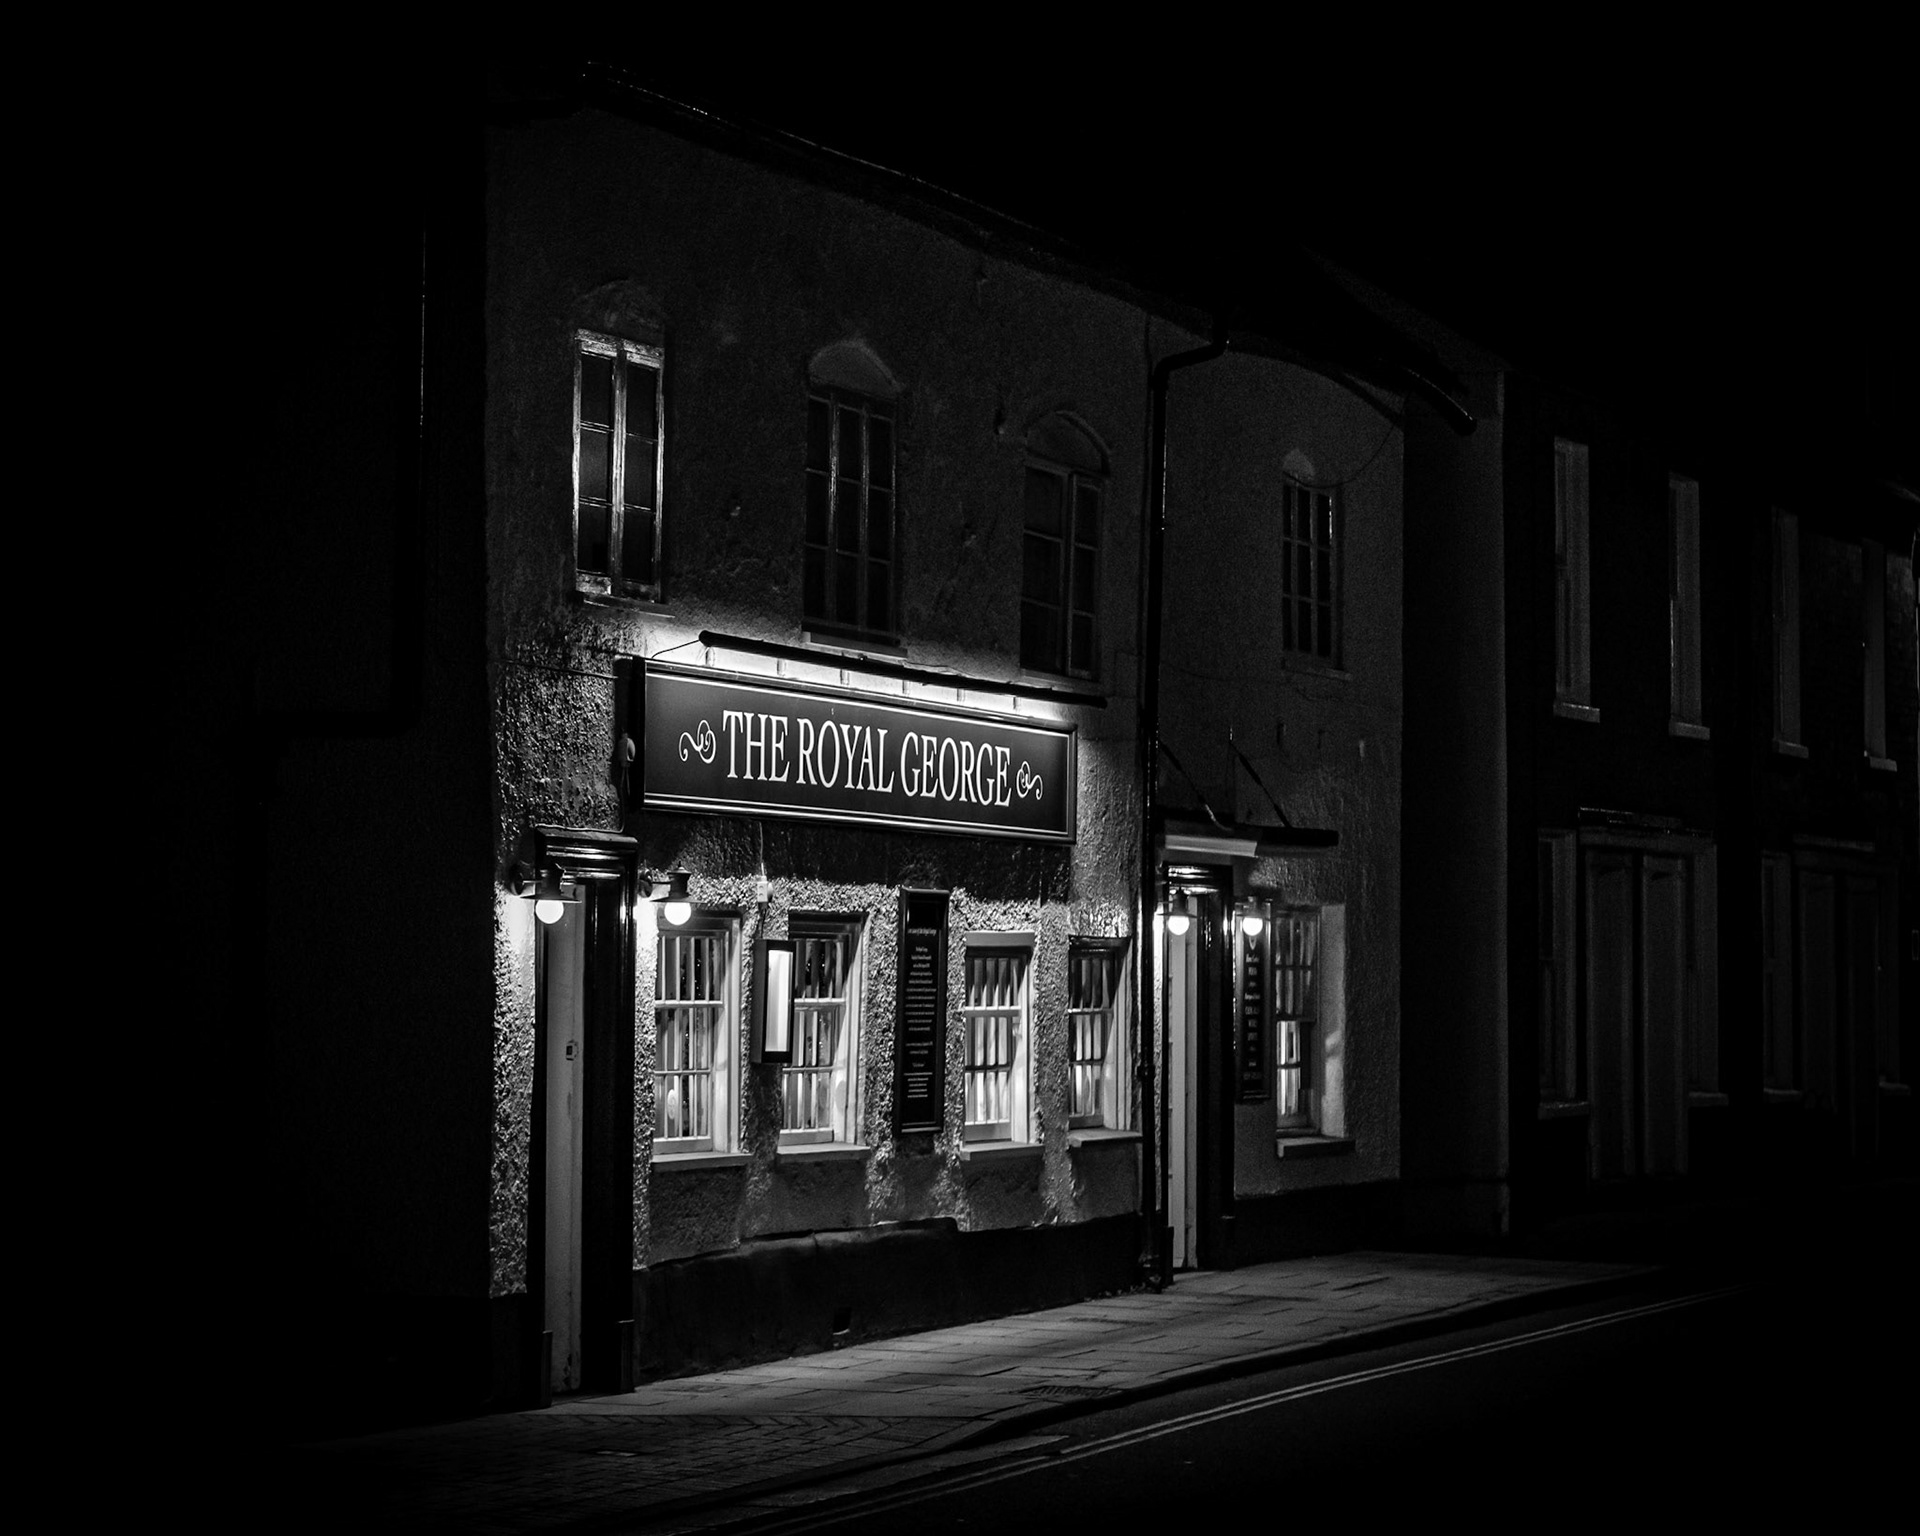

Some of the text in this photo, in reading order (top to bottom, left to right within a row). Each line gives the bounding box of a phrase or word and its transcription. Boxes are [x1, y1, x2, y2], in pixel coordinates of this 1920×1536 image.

[722, 710, 1012, 808] THE ROYAL GEORGE
